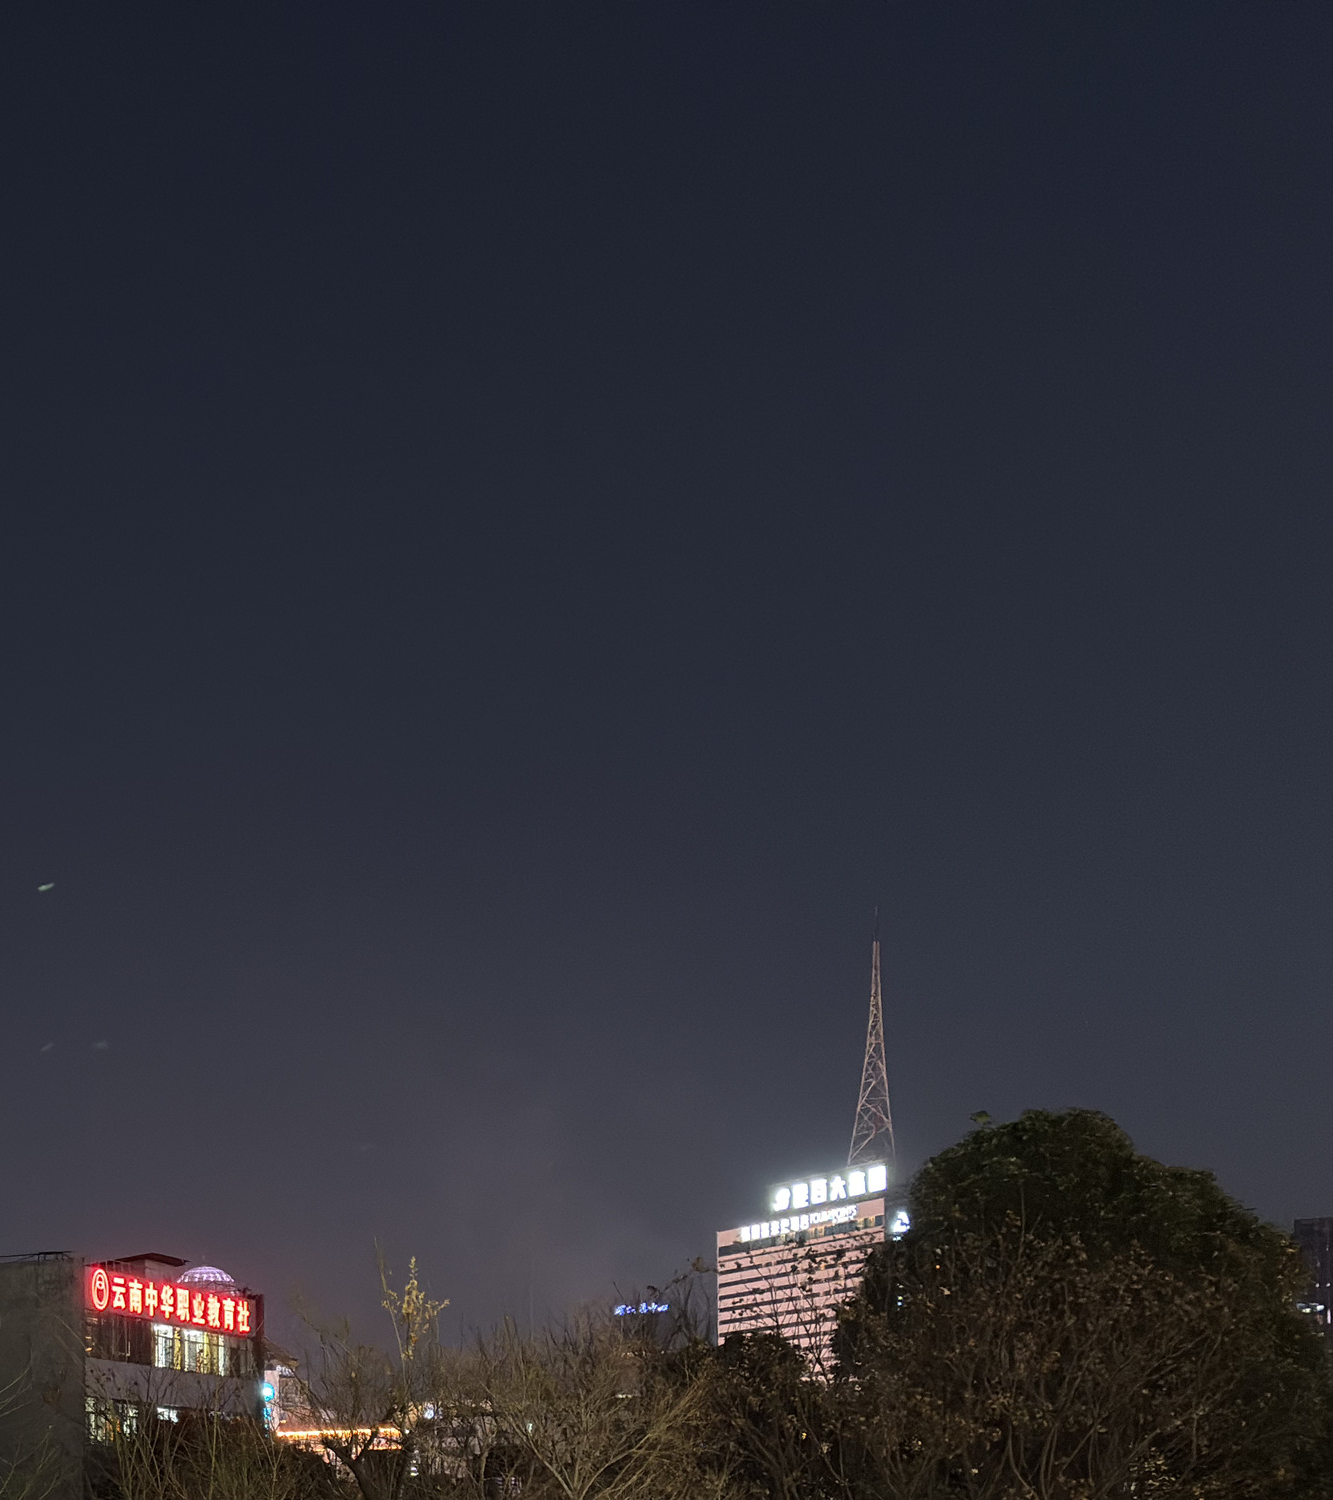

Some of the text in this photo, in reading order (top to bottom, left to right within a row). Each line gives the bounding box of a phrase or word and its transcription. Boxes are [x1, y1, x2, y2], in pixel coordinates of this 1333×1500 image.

[110, 1276, 252, 1333] 云南中华职业教育社
